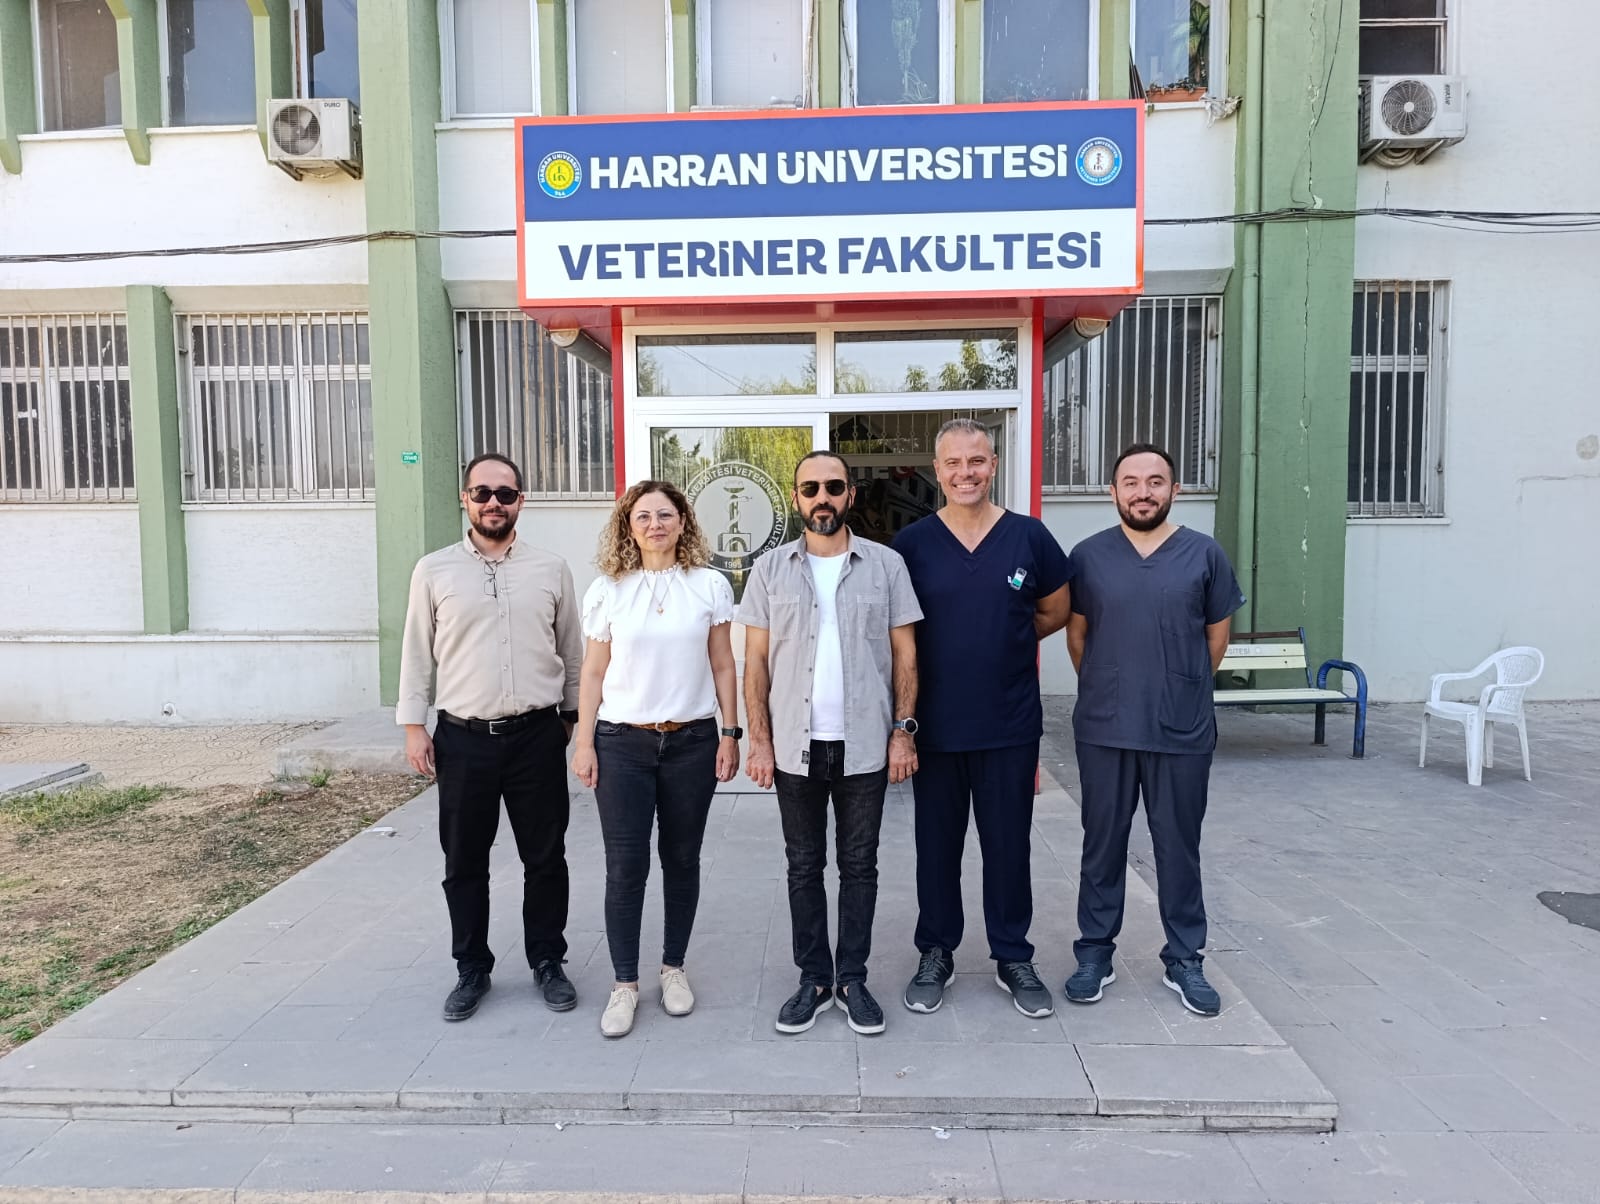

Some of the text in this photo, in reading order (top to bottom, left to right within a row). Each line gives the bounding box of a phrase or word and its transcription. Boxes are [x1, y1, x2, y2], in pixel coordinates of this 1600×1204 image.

[590, 153, 767, 189] HARRAN
[777, 144, 1068, 185] ÜNİVERSİTESİ
[558, 231, 1101, 280] VETERİNER FAKÜLTESİ
[688, 466, 733, 506] NİVERSİTESİ
[735, 467, 780, 504] VETERİNER
